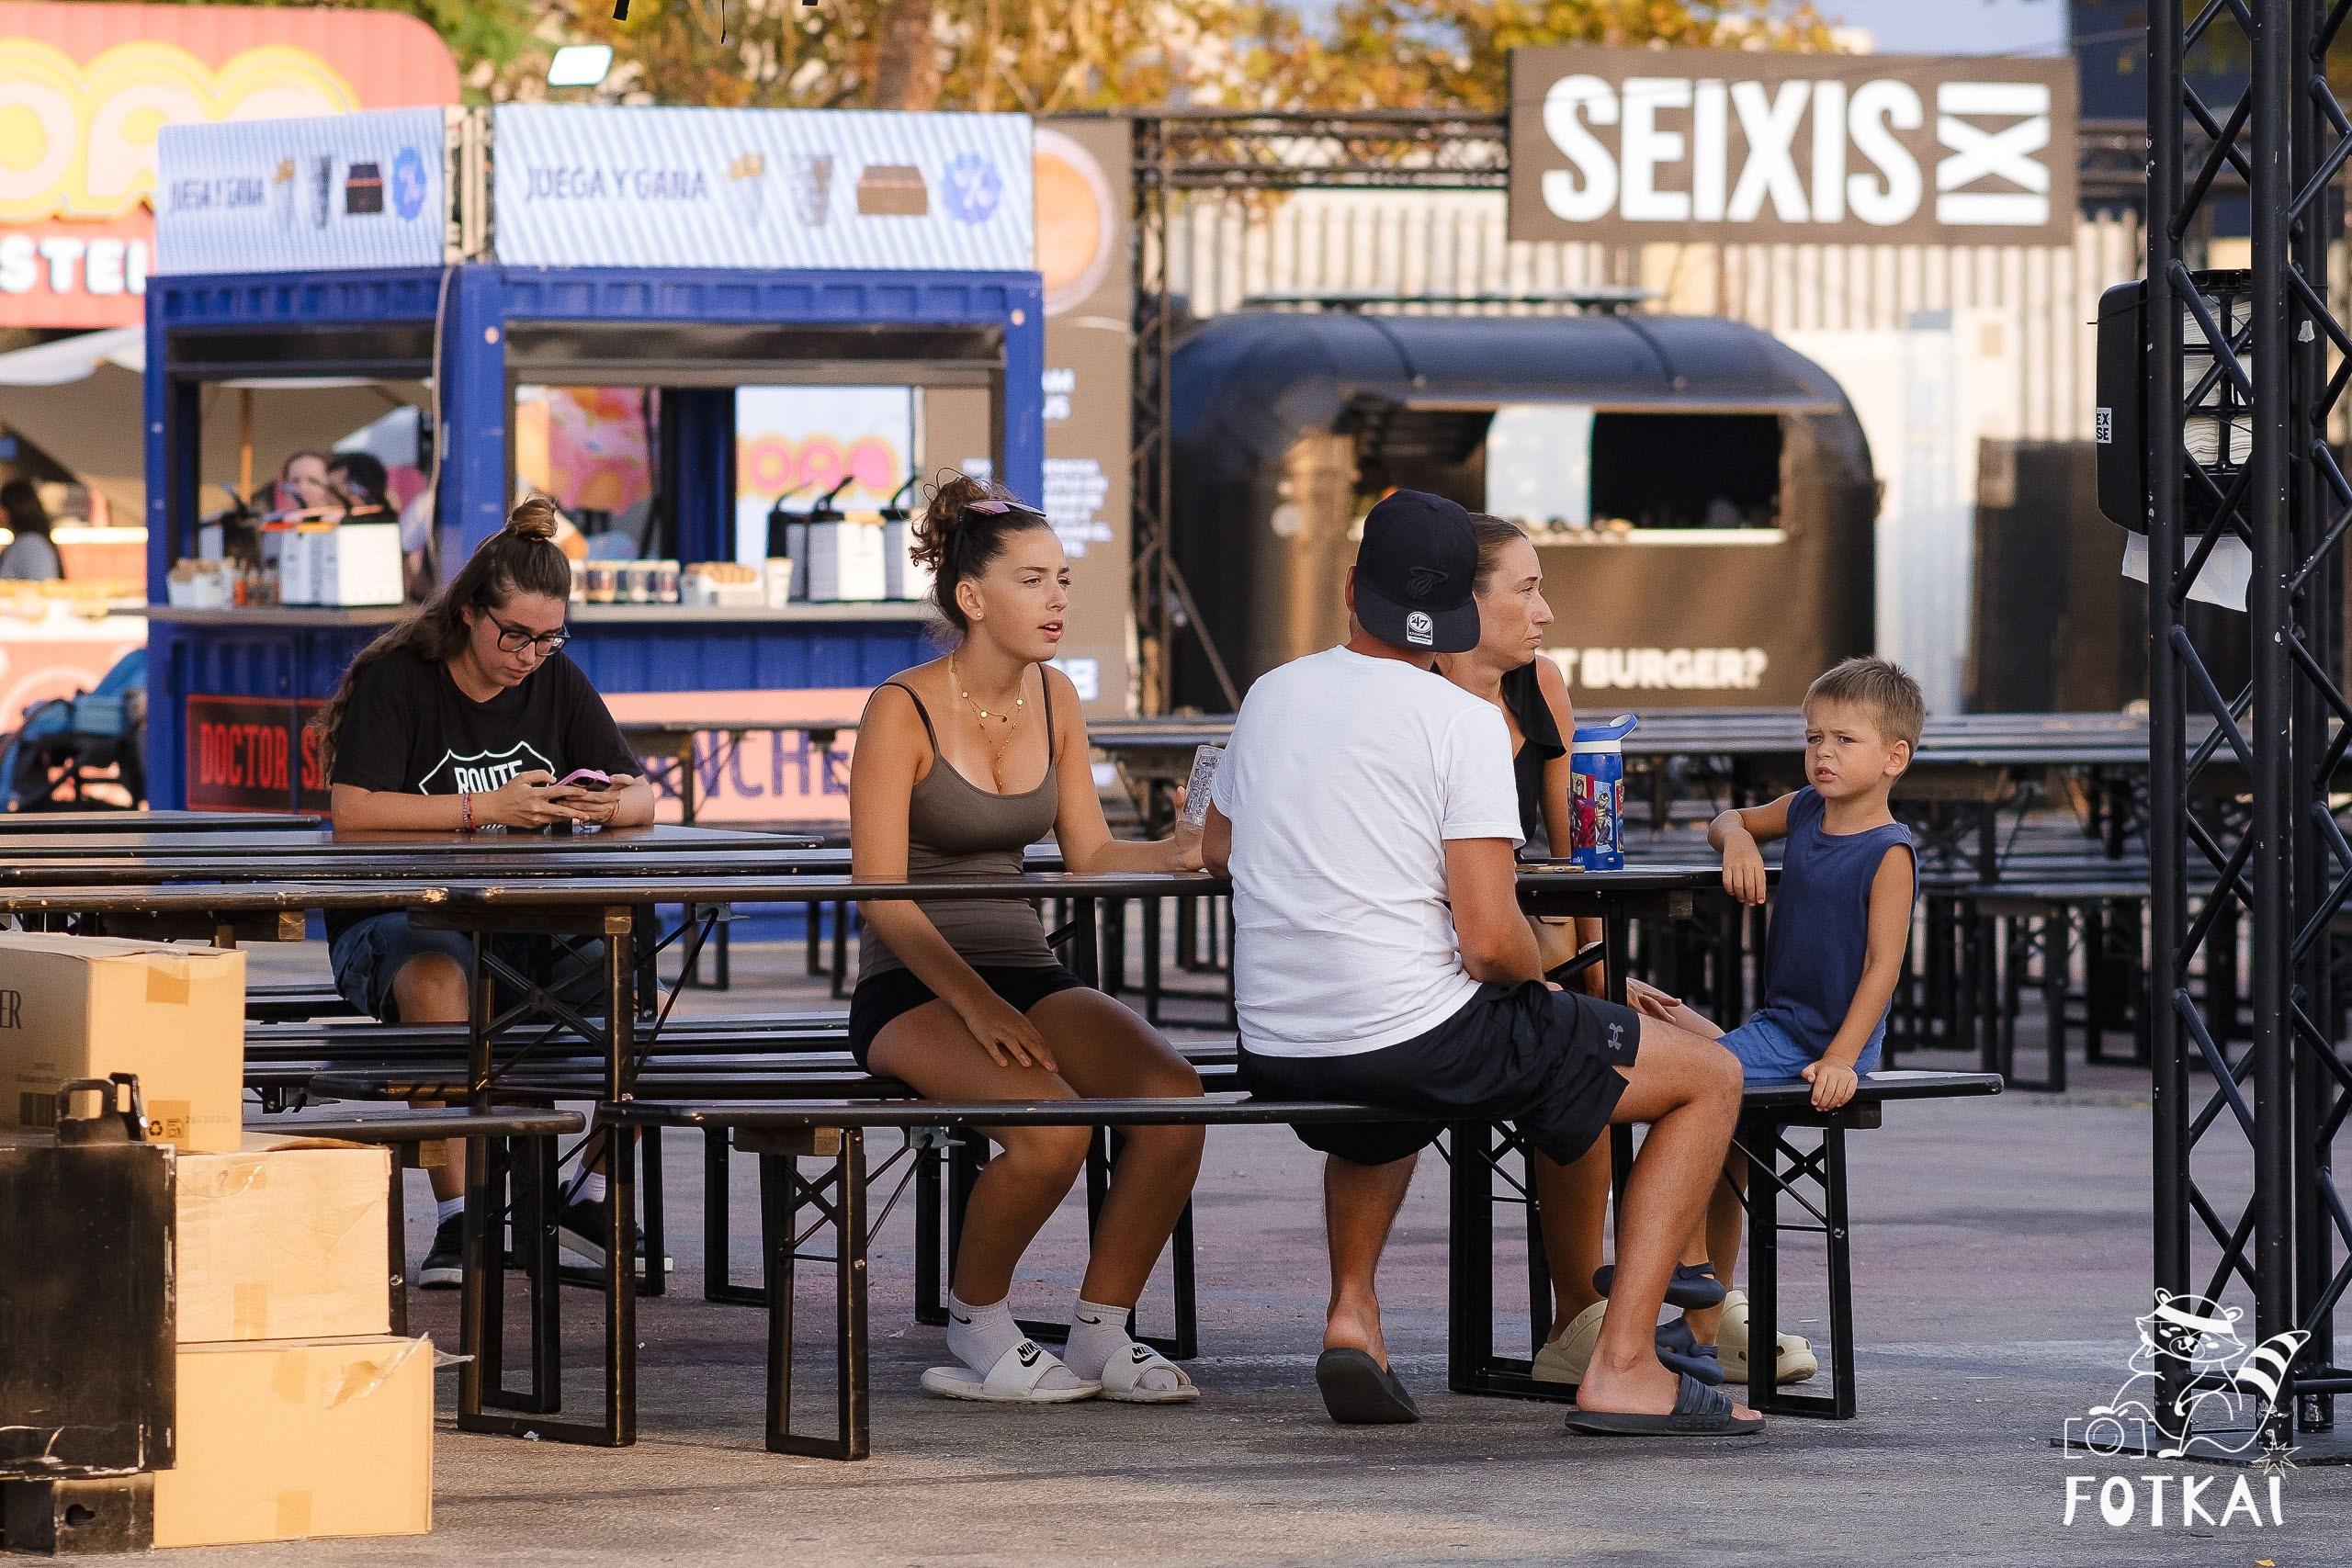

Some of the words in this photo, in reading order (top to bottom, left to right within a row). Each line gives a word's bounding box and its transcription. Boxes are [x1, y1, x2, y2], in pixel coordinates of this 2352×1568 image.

[1542, 73, 1923, 226] SEIXIS
[526, 166, 606, 204] JUEGA
[612, 167, 628, 198] Y
[634, 167, 707, 200] GANA
[1579, 647, 1769, 689] BURGER?
[199, 721, 288, 790] DOCTOR
